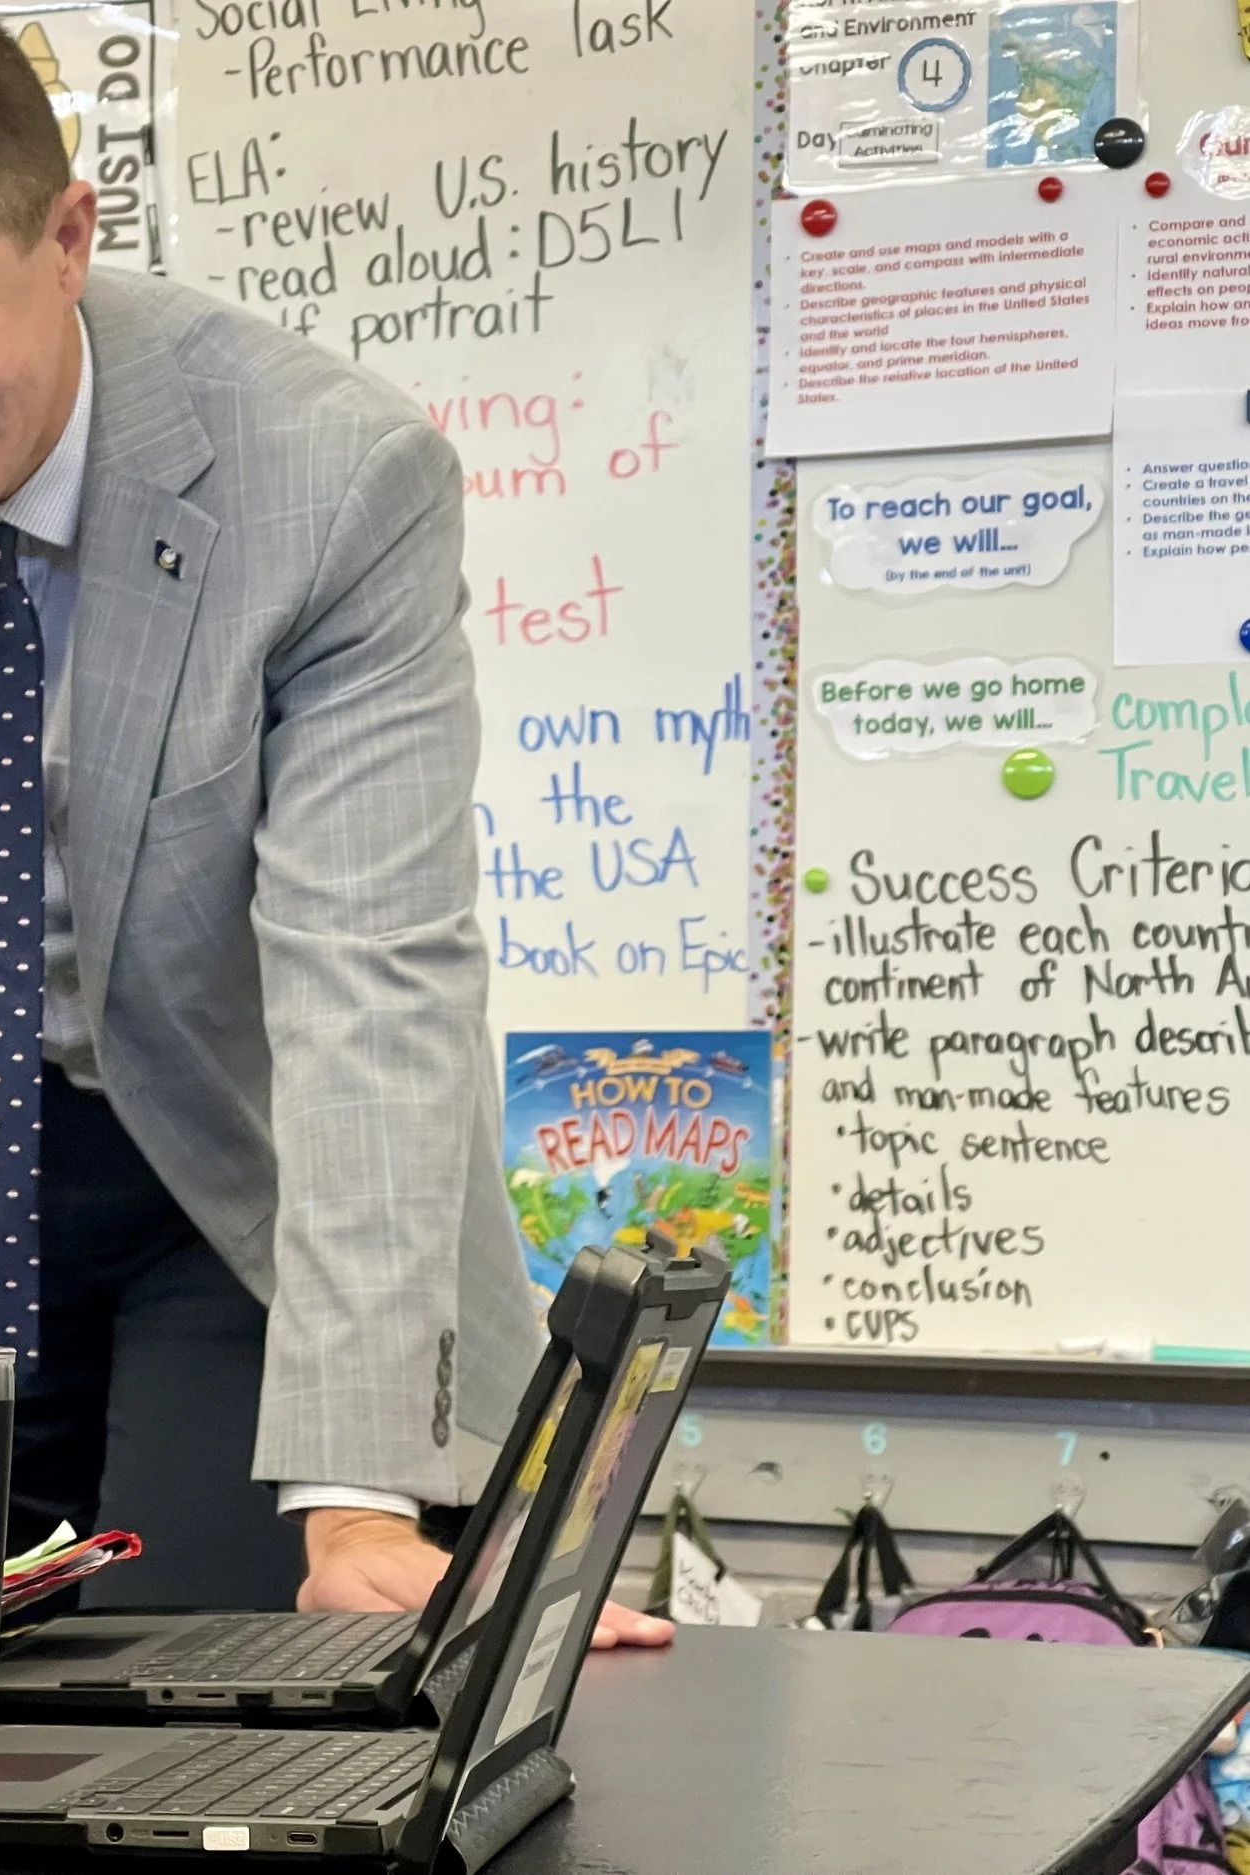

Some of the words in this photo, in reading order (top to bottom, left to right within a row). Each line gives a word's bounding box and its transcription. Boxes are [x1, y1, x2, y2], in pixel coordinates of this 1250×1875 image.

[844, 12, 977, 36] Environment
[99, 35, 140, 101] DO
[923, 60, 942, 87] 4
[797, 130, 837, 151] Day
[188, 131, 287, 205] ELA:
[435, 153, 519, 219] U.S.
[551, 117, 728, 200] history
[98, 124, 140, 252] MUST
[1148, 234, 1218, 248] economic
[1149, 217, 1214, 233] Compare
[801, 250, 845, 263] Create
[850, 246, 875, 258] and
[879, 245, 900, 256] use
[905, 241, 941, 255] maps
[946, 238, 972, 251] and
[976, 234, 1025, 248] models
[1029, 231, 1055, 243] with
[905, 257, 964, 270] compass
[969, 252, 995, 264] with
[942, 285, 995, 299] features
[1029, 277, 1086, 294] physical
[1147, 284, 1192, 297] effects
[1148, 267, 1198, 282] Identify
[351, 270, 554, 362] portrait
[915, 304, 959, 318] places
[1004, 296, 1046, 310] United
[1051, 293, 1090, 306] States
[1147, 300, 1196, 315] Explain
[1200, 297, 1228, 311] how
[1146, 317, 1183, 330] ideas
[1188, 315, 1226, 328] move
[609, 409, 682, 478] of
[1143, 462, 1194, 475] Answer
[1143, 478, 1190, 491] Create
[828, 497, 855, 521] To
[866, 492, 951, 520] reach
[962, 494, 1011, 514] our
[1022, 484, 1093, 516] goal,
[1143, 494, 1205, 508] countries
[1143, 511, 1201, 524] Describe
[899, 534, 941, 556] we
[1143, 544, 1191, 558] Explain
[1197, 541, 1226, 555] how
[1163, 526, 1241, 541] man-made
[485, 553, 624, 645] test
[821, 681, 912, 704] Before
[923, 679, 960, 698] we
[971, 679, 1002, 702] go
[1013, 674, 1085, 695] home
[518, 704, 620, 752] own
[655, 672, 750, 776] myth
[854, 712, 935, 737] today,
[945, 712, 982, 731] we
[1098, 739, 1250, 802] Travel
[541, 761, 633, 827] the
[485, 842, 564, 900] the
[592, 826, 699, 892] USA
[850, 849, 1038, 904] Success
[1019, 904, 1109, 955] each
[499, 915, 599, 977] book
[618, 940, 666, 975] on
[680, 915, 750, 993] Epic
[825, 959, 983, 1005] continent
[1020, 959, 1057, 1002] of
[1085, 954, 1194, 1002] North
[931, 1013, 1116, 1080] paragraph
[570, 1076, 658, 1109] HOW
[663, 1076, 714, 1109] TO
[822, 1066, 875, 1103] and
[895, 1073, 1052, 1113] man-made
[1074, 1065, 1231, 1115] features
[536, 1107, 638, 1174] READ
[644, 1107, 749, 1177] MAPS
[850, 1111, 939, 1169] topic
[961, 1120, 1111, 1163] sentence
[850, 1163, 973, 1215] details
[843, 1217, 1045, 1267] adjectives
[843, 1264, 1033, 1307] conclusion
[847, 1309, 919, 1342] CUPS
[863, 1422, 888, 1455] 6
[1056, 1431, 1079, 1465] 7
